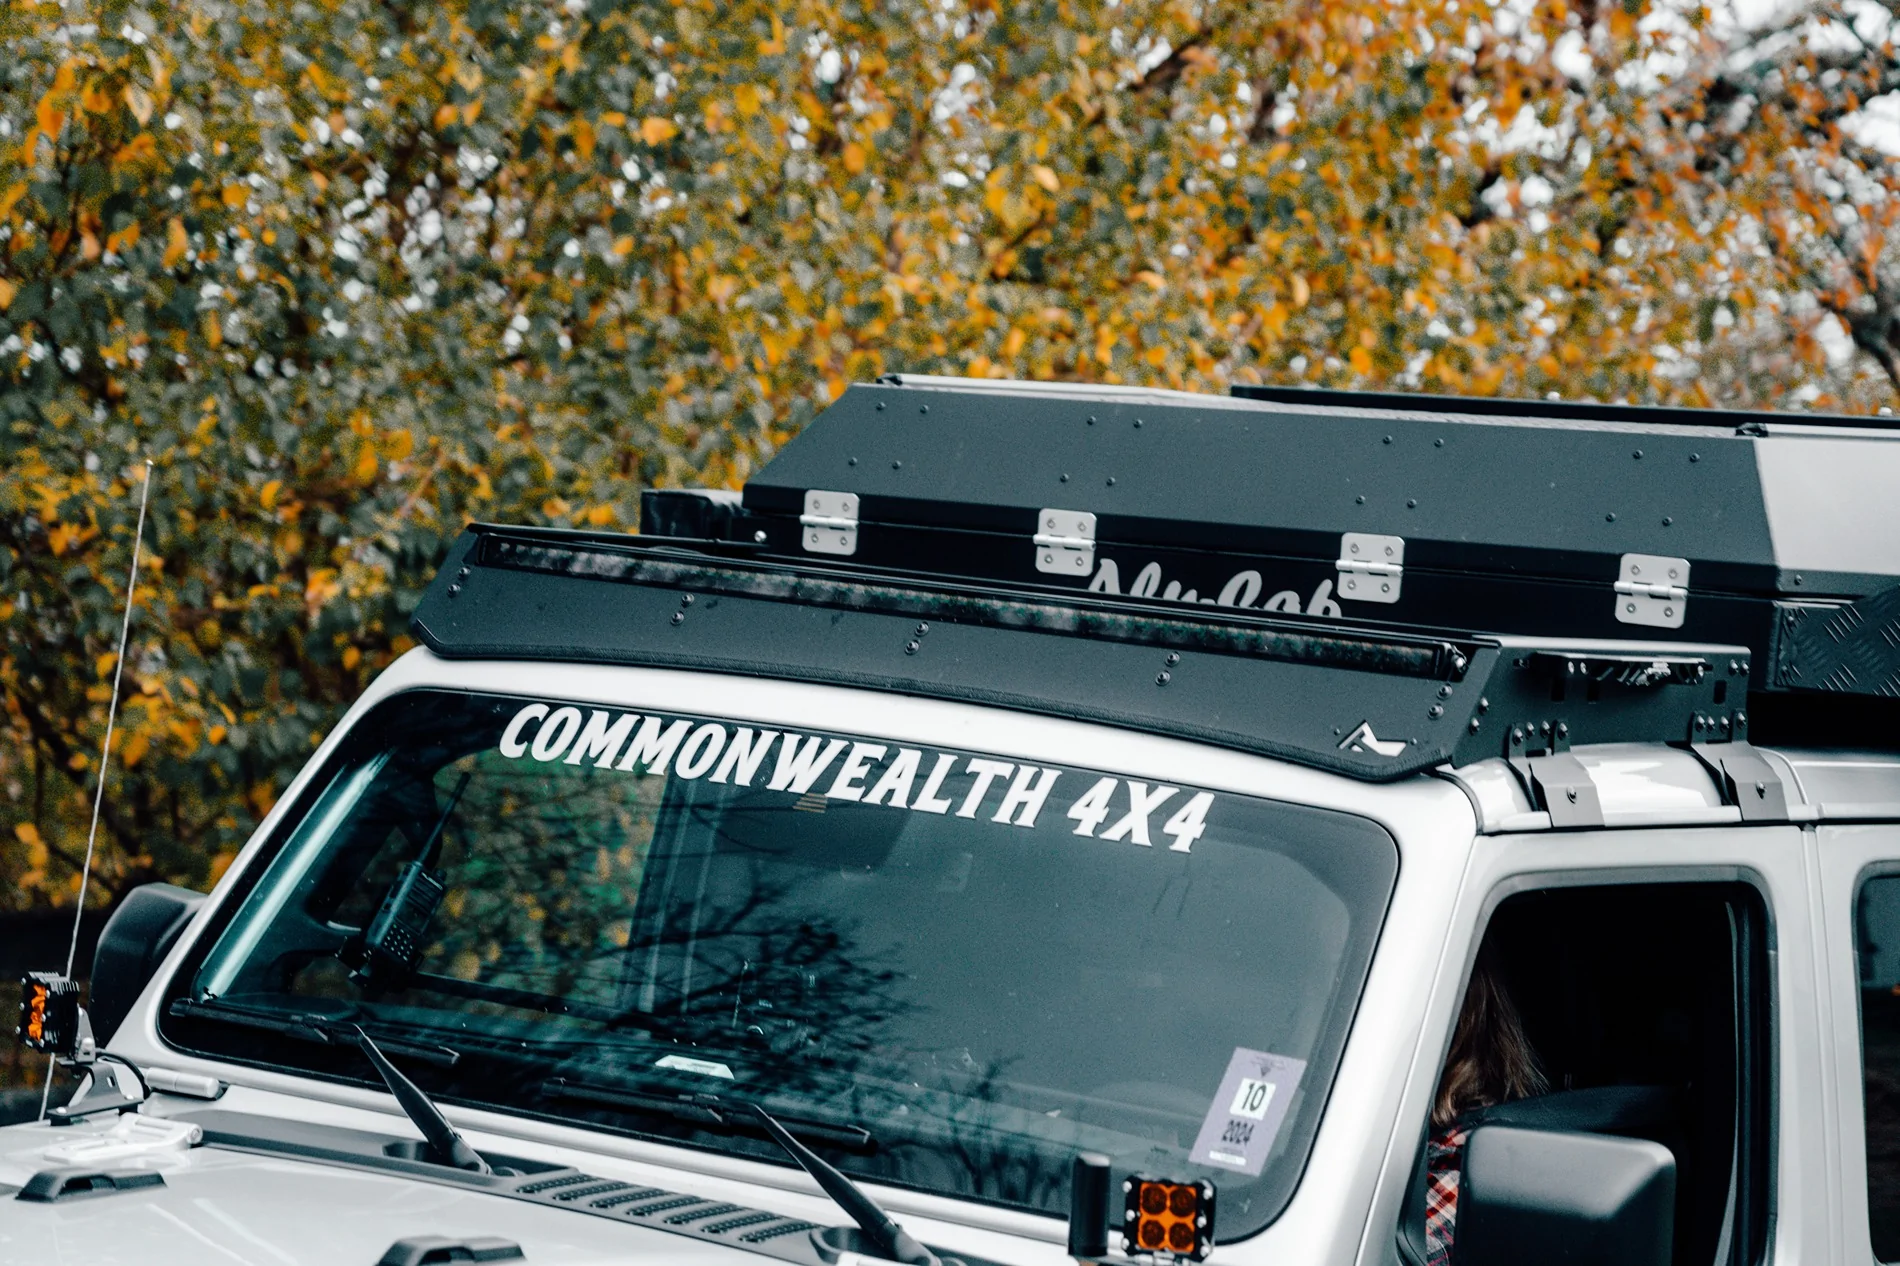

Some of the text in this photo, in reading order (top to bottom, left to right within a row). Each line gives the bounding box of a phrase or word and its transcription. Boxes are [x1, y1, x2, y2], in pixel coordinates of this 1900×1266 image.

[500, 703, 1215, 853] COMMONWEALTH 4X4
[1242, 1083, 1267, 1111] 10
